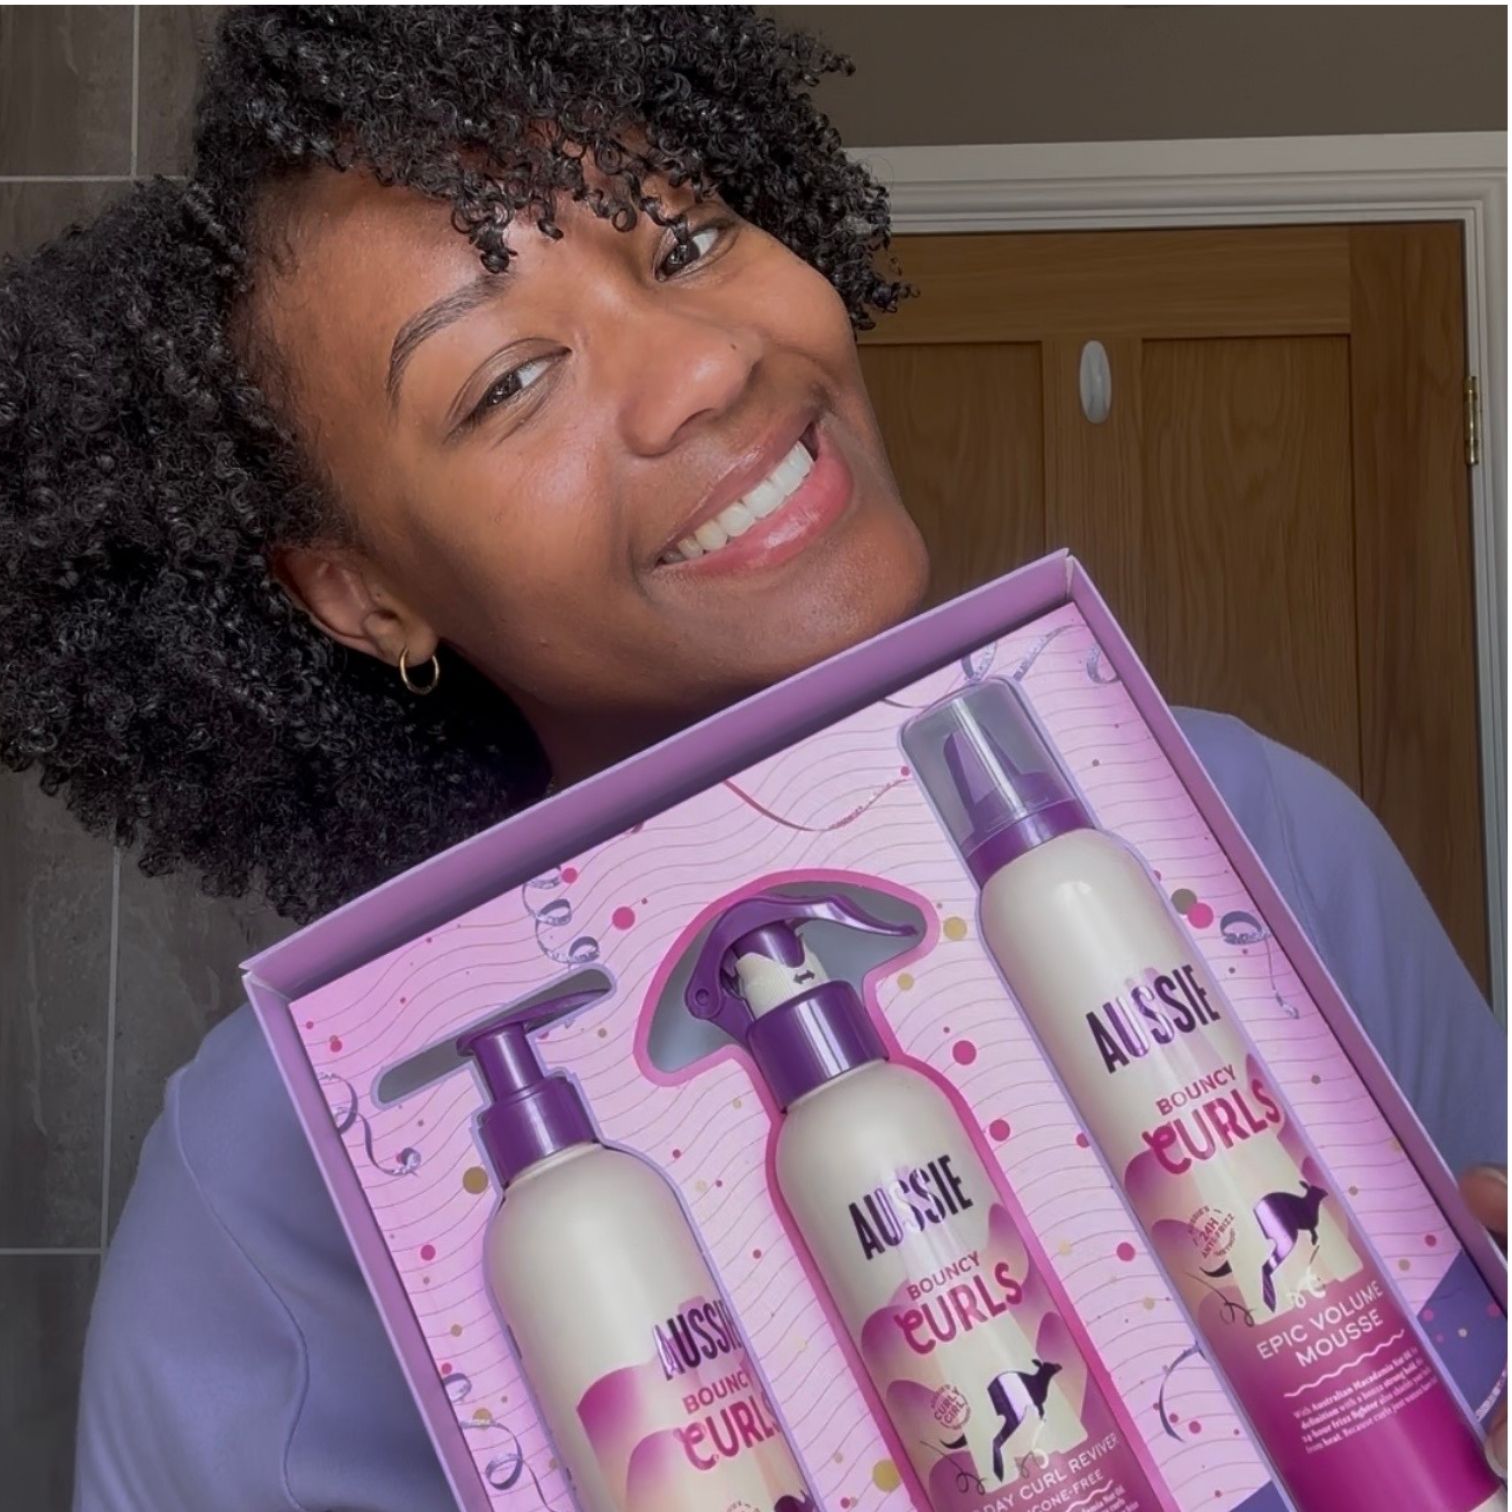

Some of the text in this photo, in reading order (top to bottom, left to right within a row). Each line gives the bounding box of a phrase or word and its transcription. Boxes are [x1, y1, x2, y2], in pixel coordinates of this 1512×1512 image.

[1085, 965, 1220, 1074] AUSSIE
[1155, 1064, 1237, 1117] BOUNCY
[1142, 1078, 1281, 1175] CURLS
[848, 1155, 973, 1260] AUSSIE
[894, 1262, 1023, 1354] CURLS
[907, 1252, 981, 1301] BOUNCY
[1257, 1281, 1384, 1360] EPIC VOLUME
[1294, 1312, 1384, 1368] MOUSSE
[683, 1369, 753, 1414] BOUNC
[934, 1386, 959, 1420] CURLY
[1020, 1469, 1067, 1500] CURL
[1068, 1433, 1120, 1473] REVIVER
